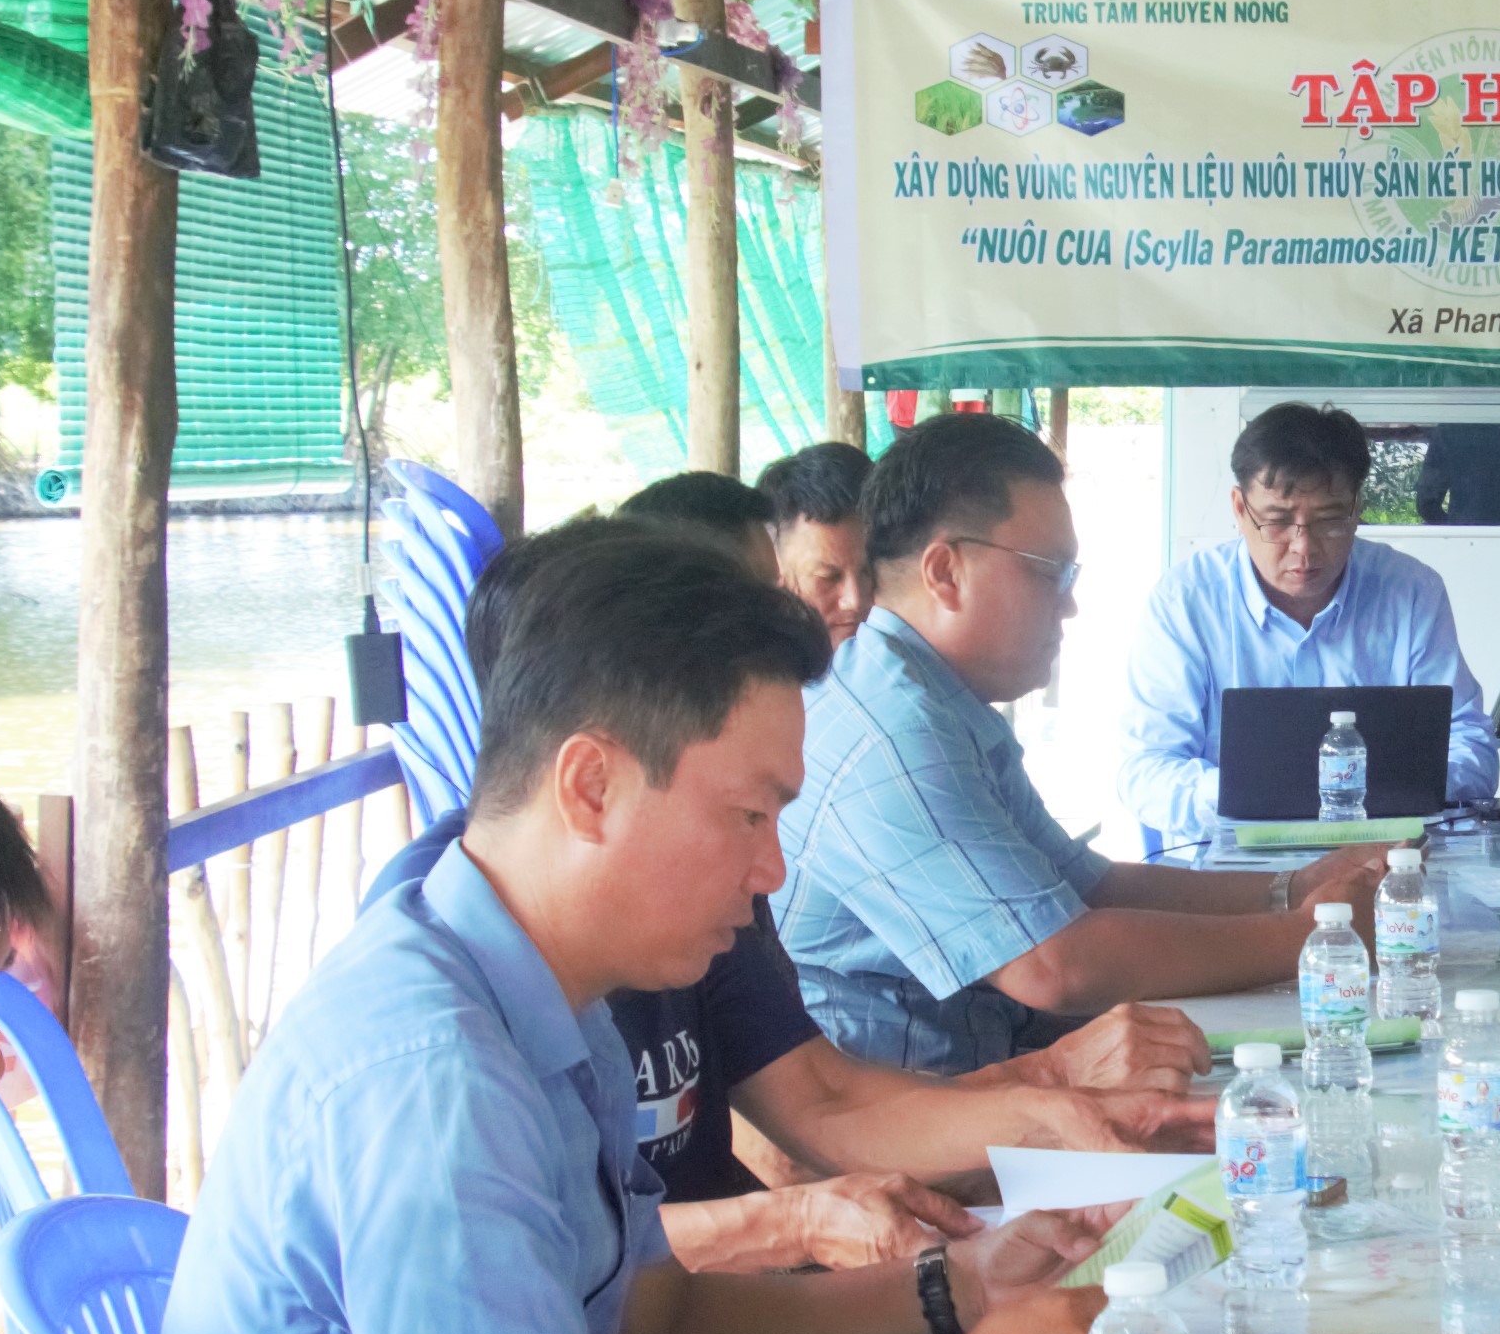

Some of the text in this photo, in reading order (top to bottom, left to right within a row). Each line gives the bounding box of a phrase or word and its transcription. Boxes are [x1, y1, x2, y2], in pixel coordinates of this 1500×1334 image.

[1021, 2, 1088, 24] TRUNG
[1290, 58, 1439, 138] TẬP
[894, 151, 939, 198] XÂY
[947, 156, 1009, 206] DỰNG
[1016, 154, 1077, 200] VÙNG
[1084, 152, 1174, 199] NGUYÊN
[1182, 152, 1234, 207] LIỆU
[1243, 152, 1296, 198] NUÔI
[1304, 147, 1366, 198] THỦY
[1373, 147, 1419, 198] SẢN
[1427, 147, 1472, 198] KẾT
[1056, 229, 1112, 266] CUA
[1124, 229, 1214, 272] (Scylla
[1223, 227, 1438, 267] Paramamosain)
[1388, 308, 1424, 334] Xã
[636, 1029, 701, 1096] ARIS
